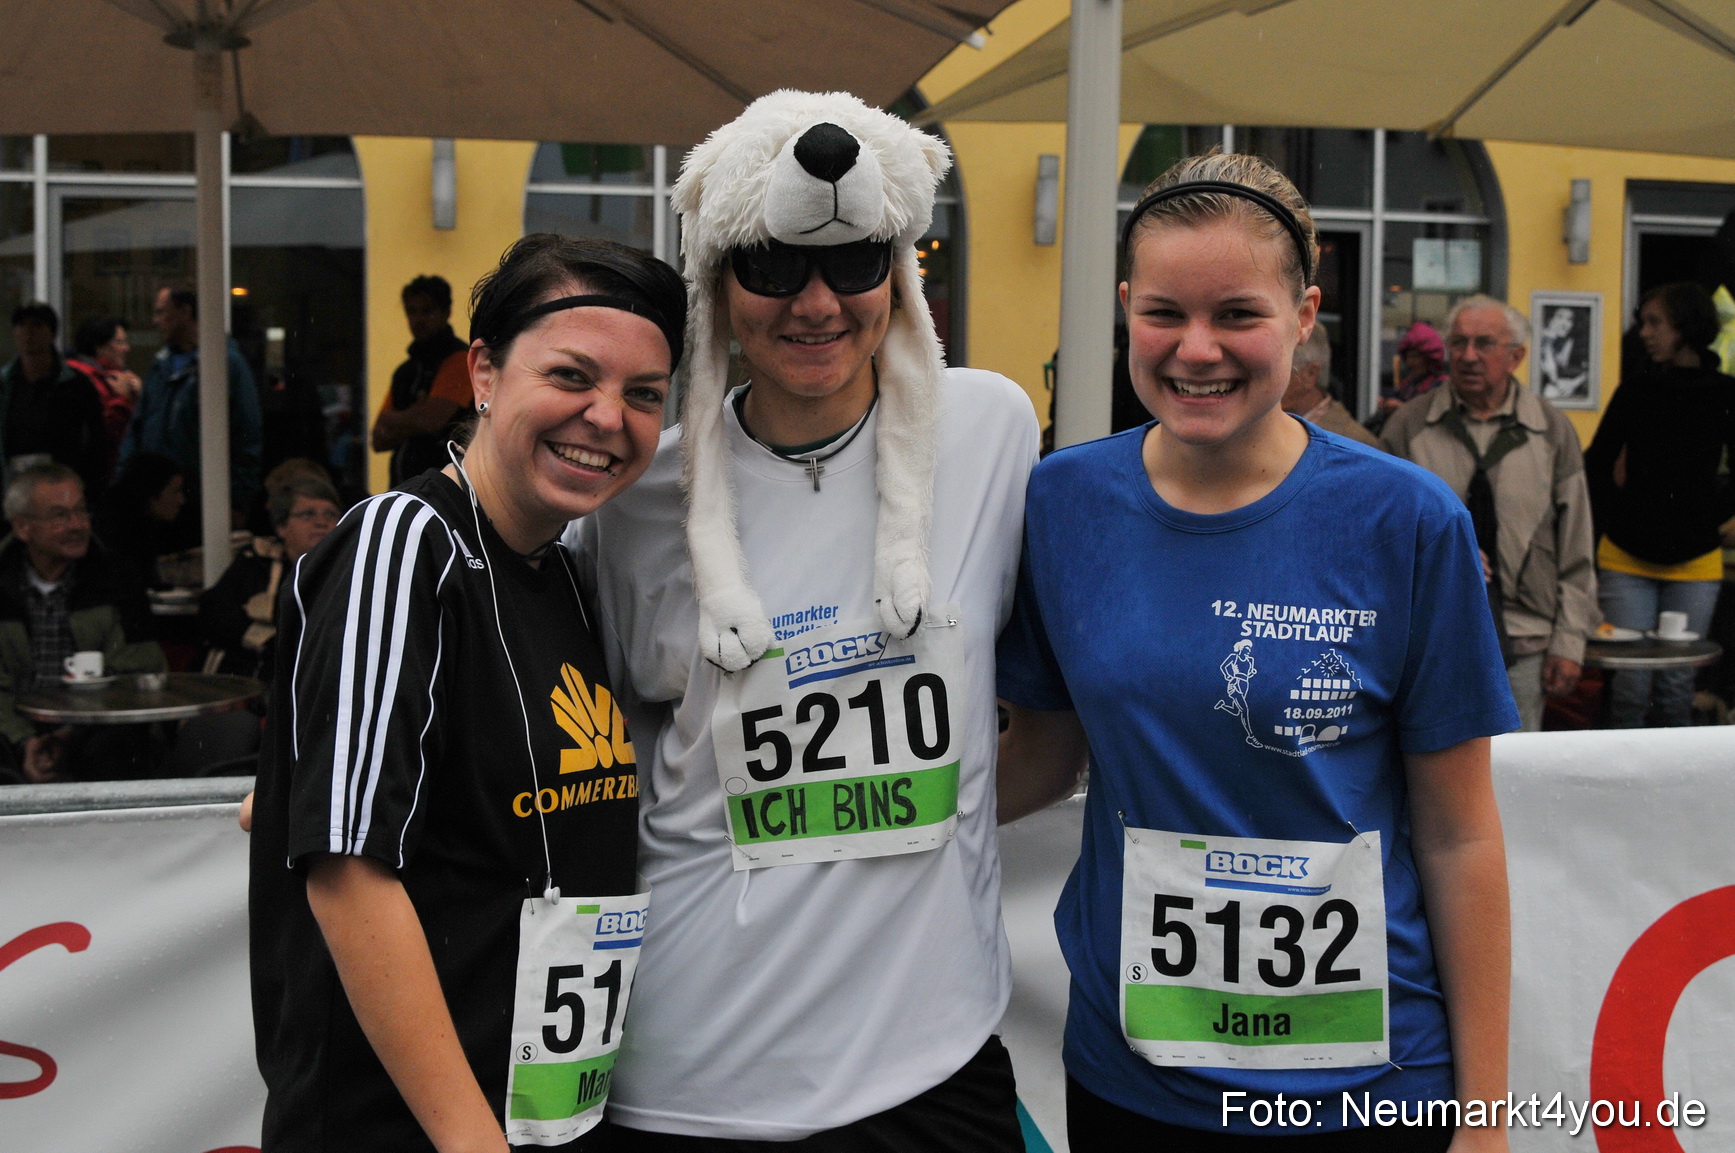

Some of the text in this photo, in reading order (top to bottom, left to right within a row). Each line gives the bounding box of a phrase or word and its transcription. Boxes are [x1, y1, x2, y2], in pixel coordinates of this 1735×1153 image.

[768, 604, 839, 630] umarkter
[1211, 600, 1378, 627] 12. NEUMARKTER
[1240, 620, 1354, 643] STADTLAUF
[785, 631, 885, 676] BOCK
[741, 672, 951, 782] 5210
[1283, 704, 1353, 720] 18.09.2011
[741, 777, 917, 839] ICH BINS
[1205, 850, 1310, 880] BOCK
[1151, 893, 1361, 988] 5132
[542, 958, 637, 1054] 51
[1212, 1003, 1292, 1038] Jana
